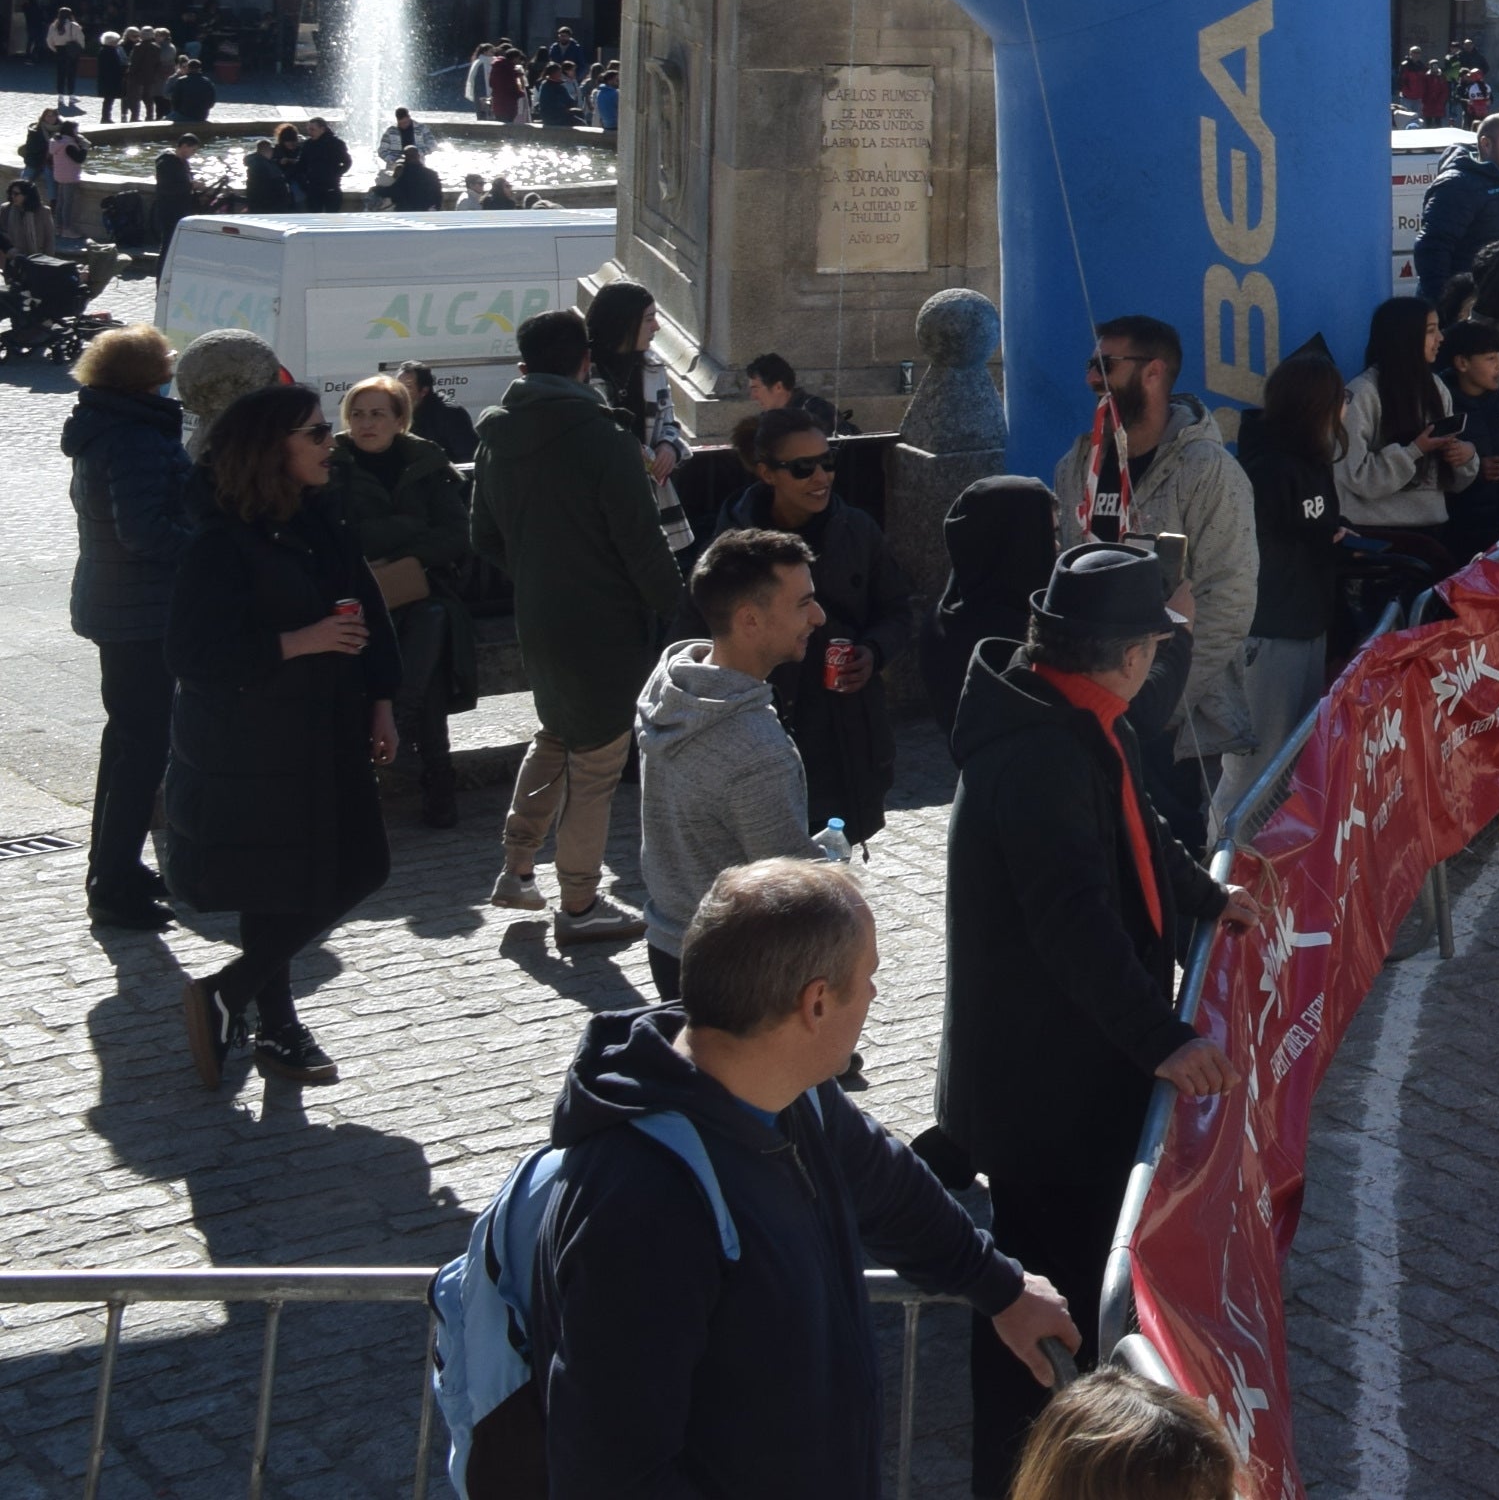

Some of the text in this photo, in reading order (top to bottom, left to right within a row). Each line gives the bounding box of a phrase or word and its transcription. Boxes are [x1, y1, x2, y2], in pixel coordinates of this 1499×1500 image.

[827, 89, 929, 102] CARLOS RUMSEY
[842, 108, 914, 119] DE NEW YORK
[831, 120, 925, 131] ESTADOS UNIDOS
[862, 137, 876, 148] LA
[881, 137, 930, 148] ESTATUA
[846, 167, 883, 183] SEÑORA
[886, 170, 928, 183] RUMSEY
[852, 186, 866, 197] LA
[862, 201, 900, 212] CIUDAD
[904, 201, 918, 212] DE
[850, 212, 900, 223] TRUJILLO
[1398, 213, 1422, 232] Roj
[324, 380, 353, 394] Dele
[1302, 495, 1325, 519] RB
